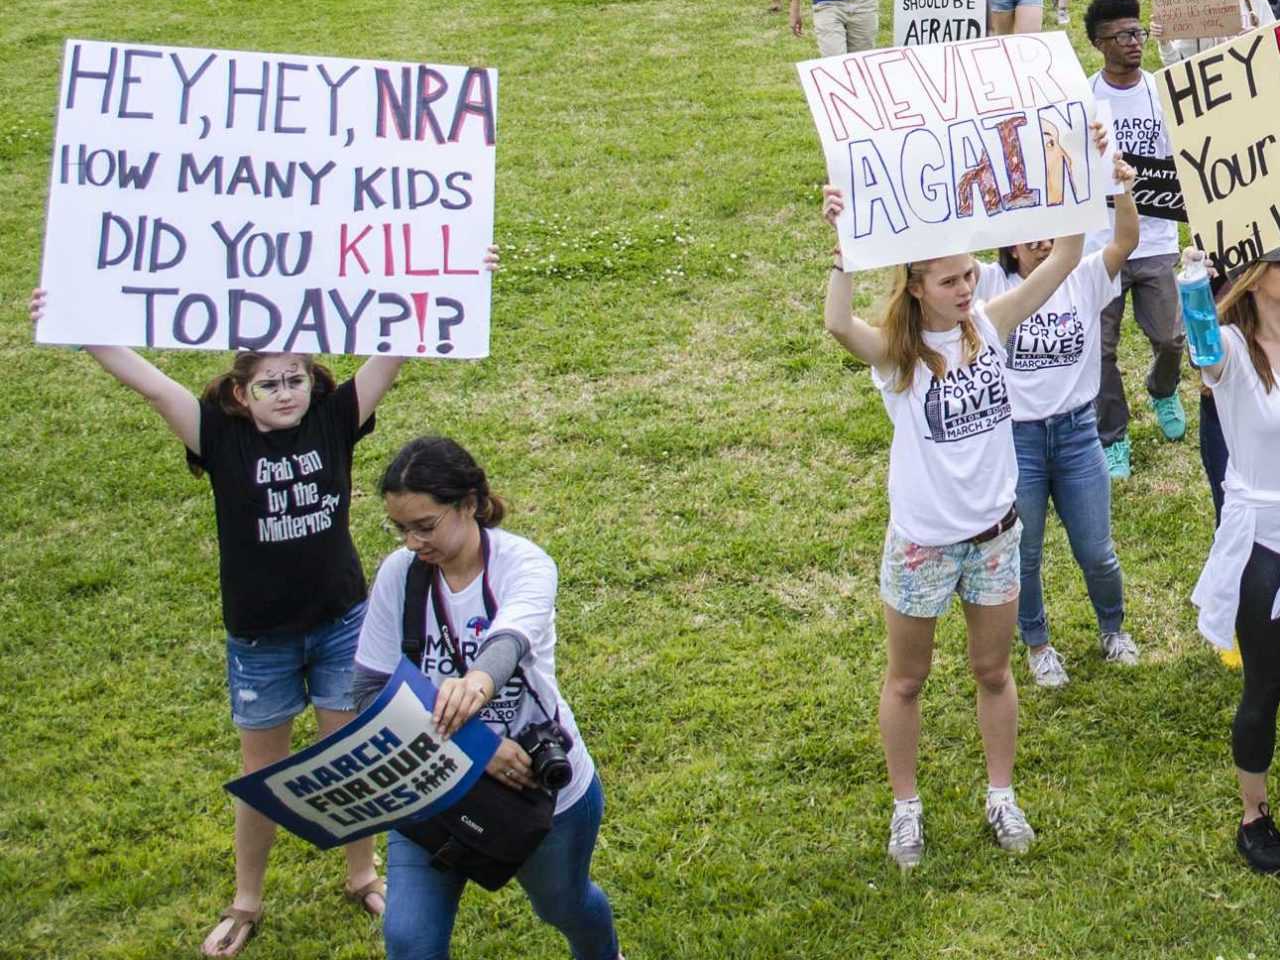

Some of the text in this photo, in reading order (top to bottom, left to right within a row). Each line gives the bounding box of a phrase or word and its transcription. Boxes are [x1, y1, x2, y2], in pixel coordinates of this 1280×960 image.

[66, 44, 497, 147] HEY, HEY, NRA
[811, 35, 1069, 142] NEVER
[1164, 36, 1263, 127] HEY
[1137, 130, 1160, 140] OUR
[60, 144, 473, 212] HOW MANY KIDS
[848, 101, 1091, 239] AGAIN
[1180, 134, 1276, 205] Your
[97, 212, 480, 279] DID YOU KILL
[122, 286, 465, 354] TODAY?!?
[1016, 334, 1084, 354] LIVES
[1019, 325, 1049, 338] FOR
[943, 380, 975, 400] FOR
[947, 425, 983, 438] MARCH
[256, 450, 323, 484] Grab 'em
[268, 481, 319, 515] by the
[258, 508, 332, 542] Midterms
[284, 725, 403, 798] MARCH
[306, 731, 441, 813] FOR OUR
[329, 783, 419, 827] LIVES
